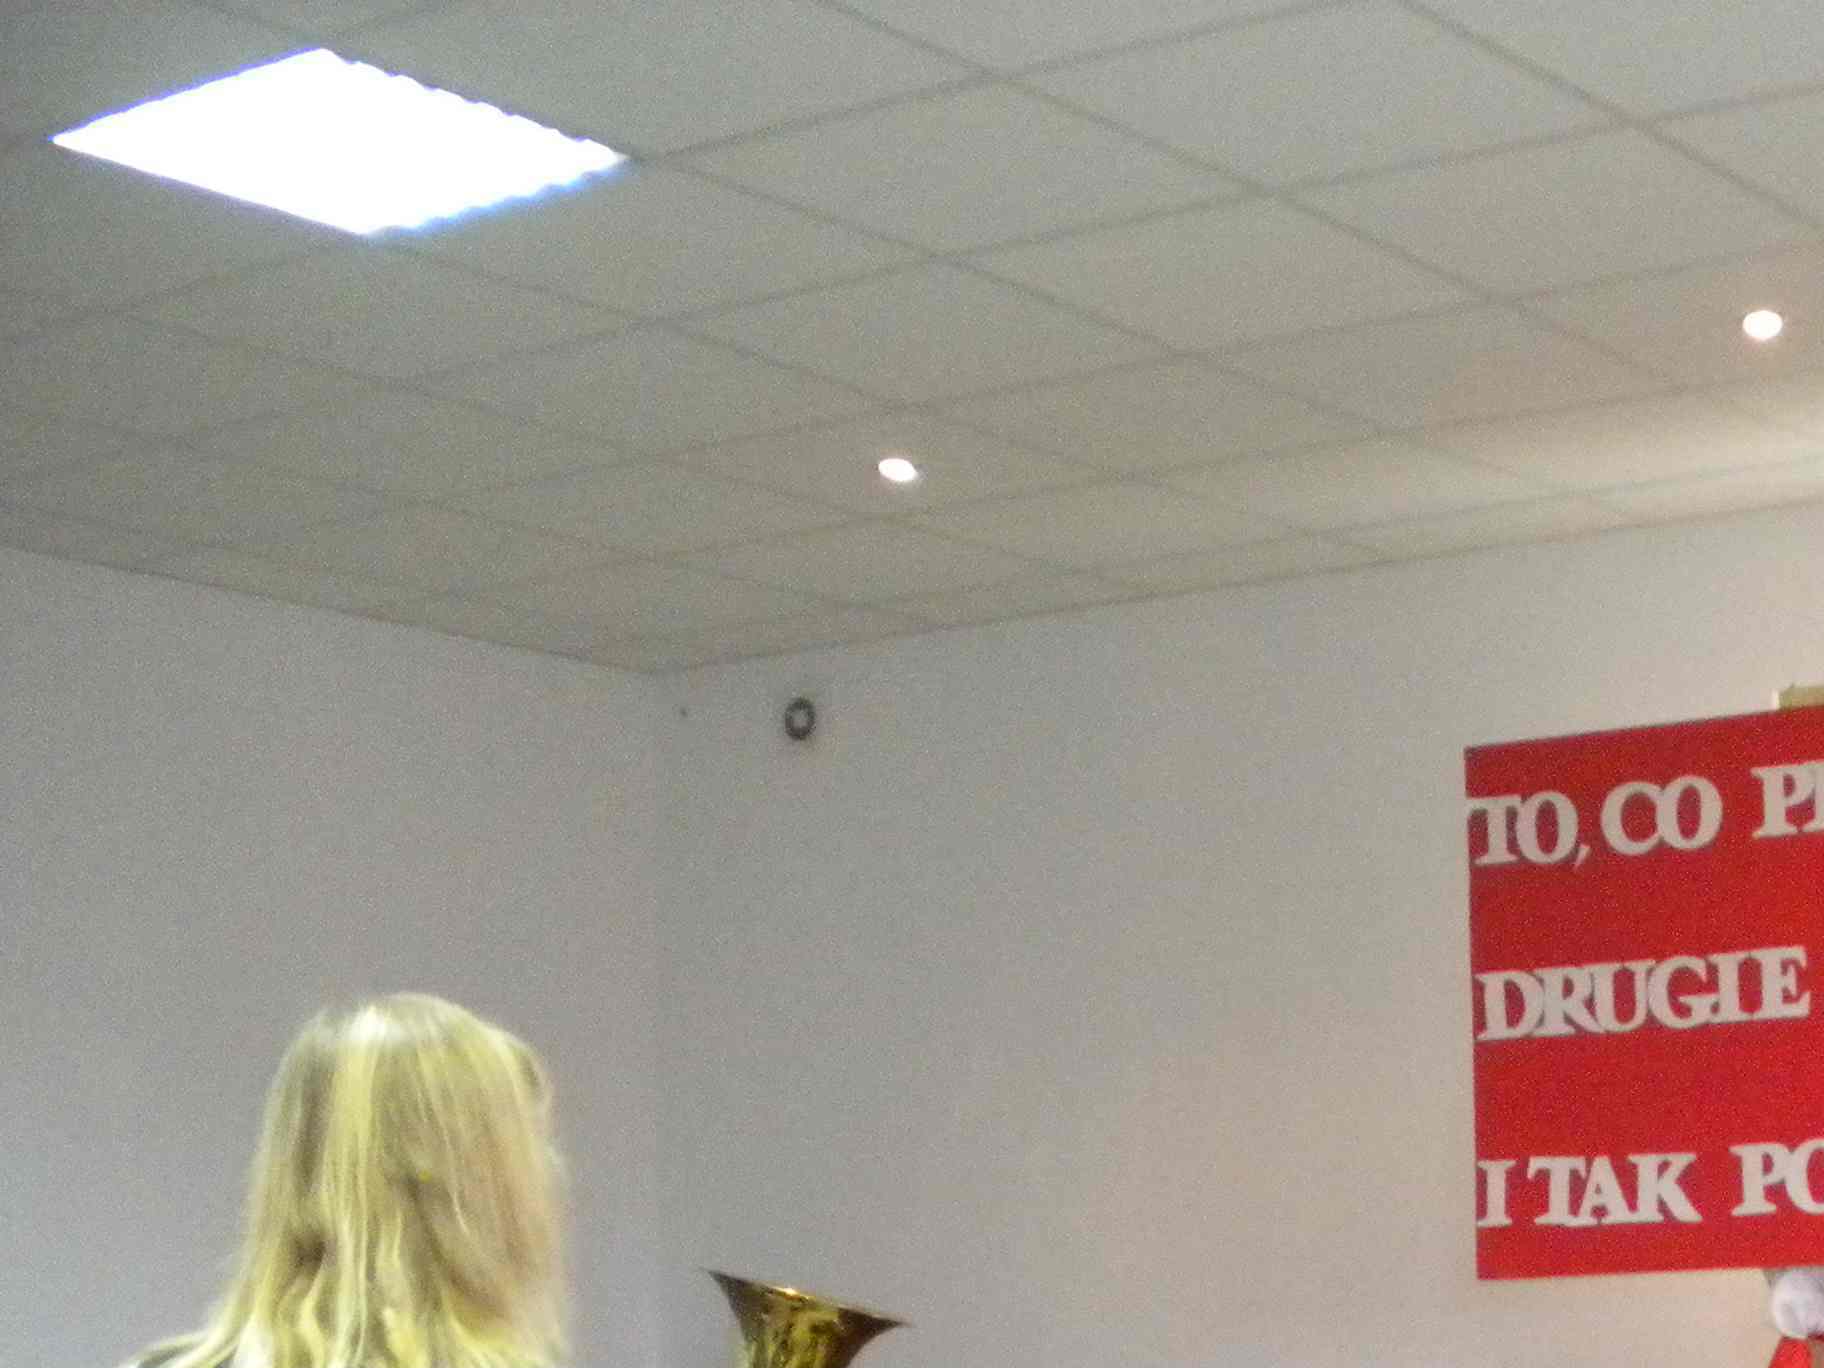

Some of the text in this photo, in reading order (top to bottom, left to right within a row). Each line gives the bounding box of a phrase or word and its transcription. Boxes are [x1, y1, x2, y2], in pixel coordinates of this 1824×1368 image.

[1466, 791, 1589, 868] TO,
[1601, 776, 1723, 857] CO
[1475, 946, 1810, 1041] DRUGIE
[1475, 1158, 1516, 1229] I
[1527, 1150, 1703, 1229] TAK
